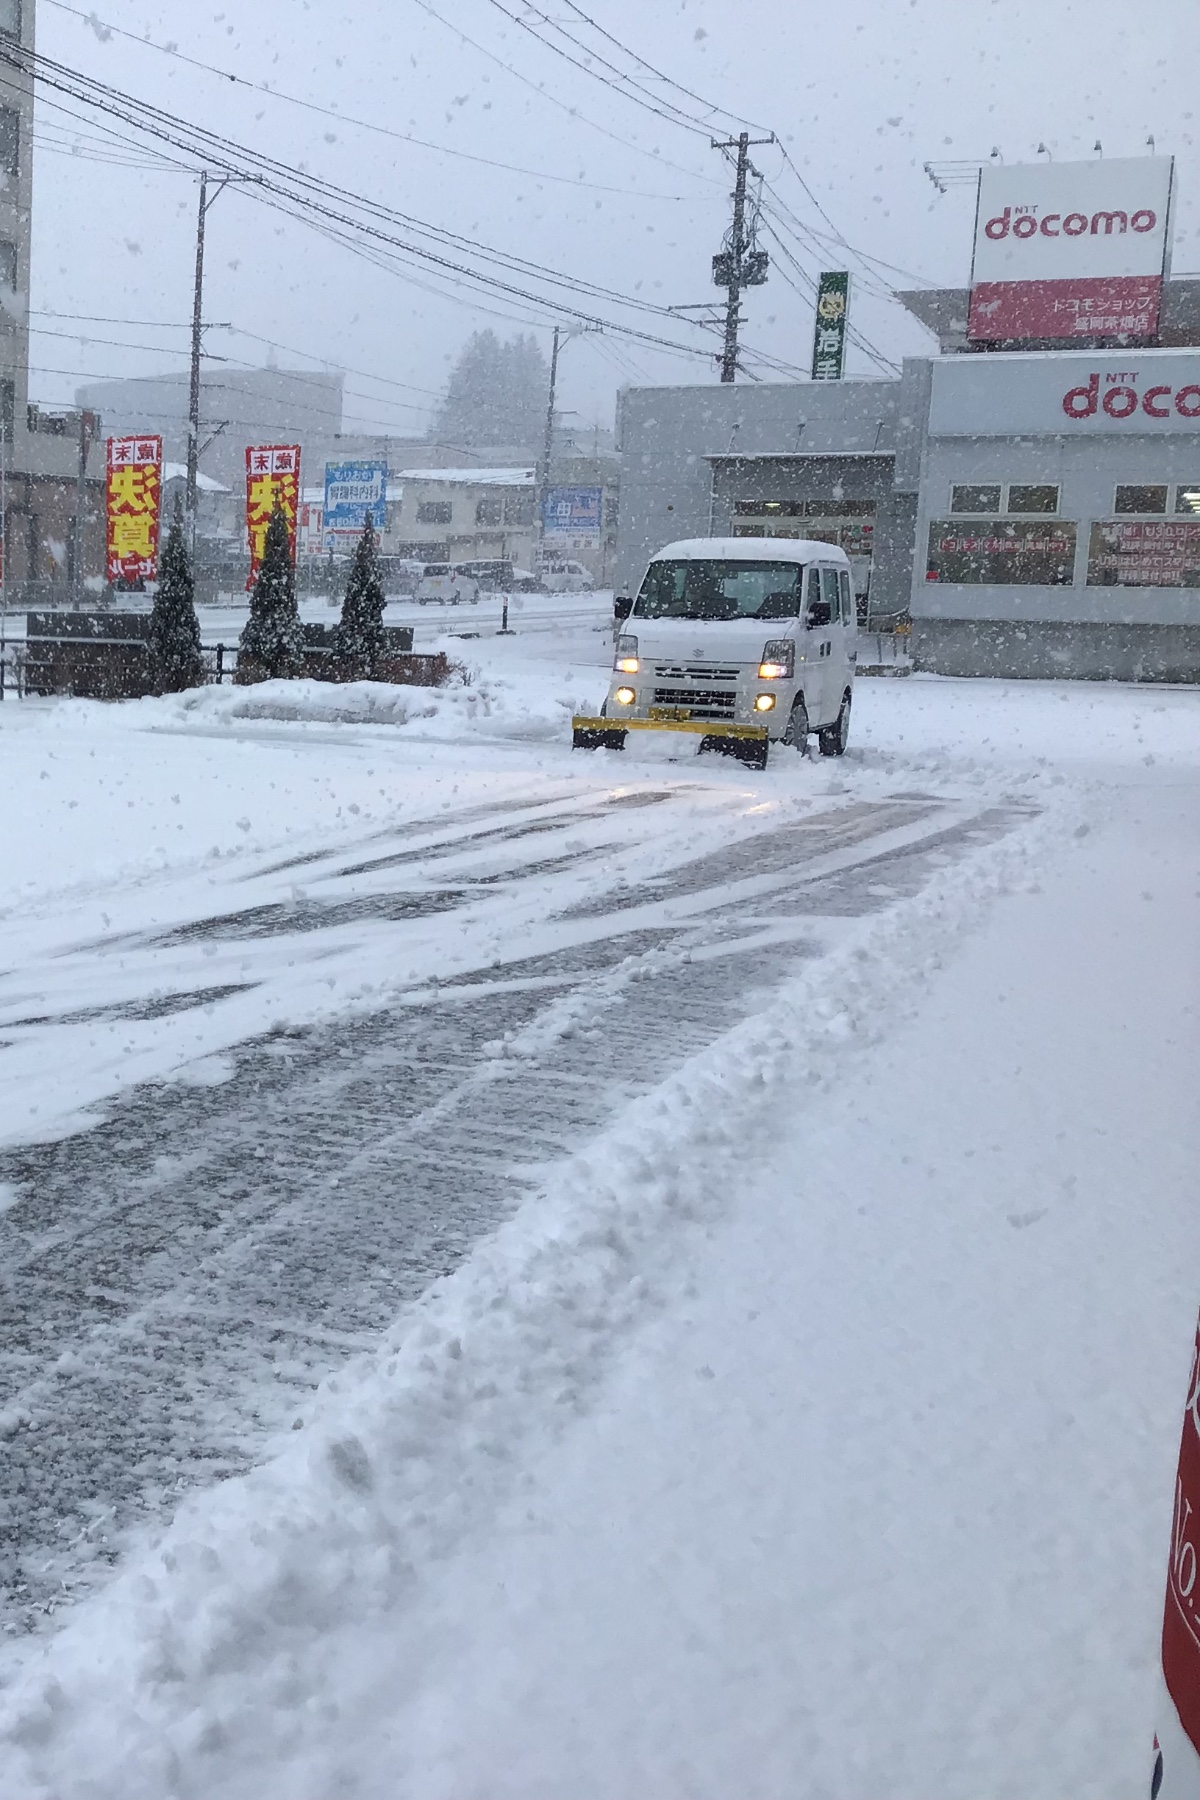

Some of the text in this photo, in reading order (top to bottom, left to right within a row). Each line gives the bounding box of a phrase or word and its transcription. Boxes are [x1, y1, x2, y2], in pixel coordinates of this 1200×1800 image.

[1015, 205, 1039, 214] NTT
[985, 206, 1157, 240] docomo
[1106, 372, 1140, 383] NTT
